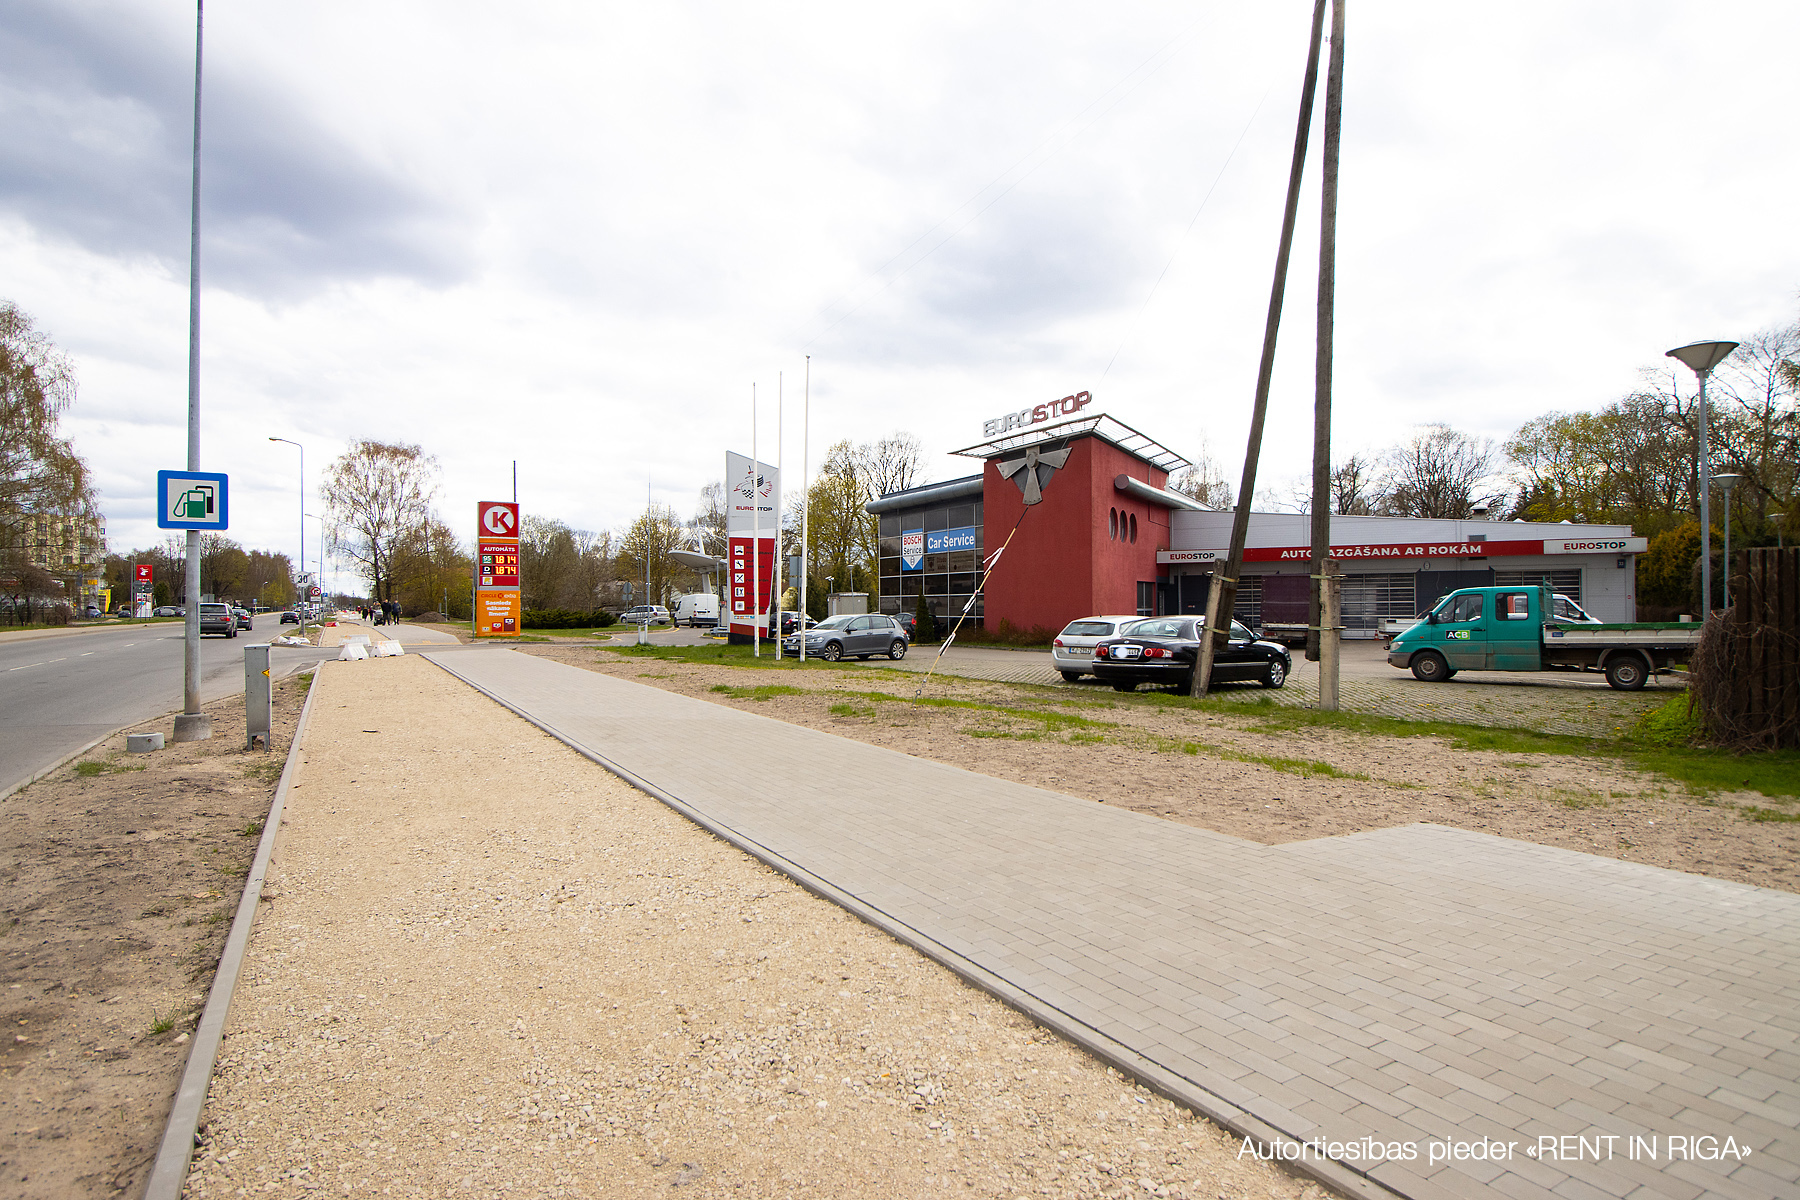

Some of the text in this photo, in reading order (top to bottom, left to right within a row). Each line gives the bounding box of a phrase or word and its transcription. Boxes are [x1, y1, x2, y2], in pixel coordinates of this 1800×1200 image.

[983, 391, 1092, 438] EUROSTOP
[492, 511, 511, 533] K
[903, 535, 922, 546] BOSCH
[928, 532, 975, 550] Car Service
[903, 547, 922, 555] Service
[1281, 543, 1482, 559] AUTOAZGĀŠANA AR ROKĀM
[1563, 541, 1627, 551] EUROSTOP
[1170, 552, 1215, 561] EUROSTOP
[298, 574, 308, 584] 30
[1447, 631, 1469, 639] ACB
